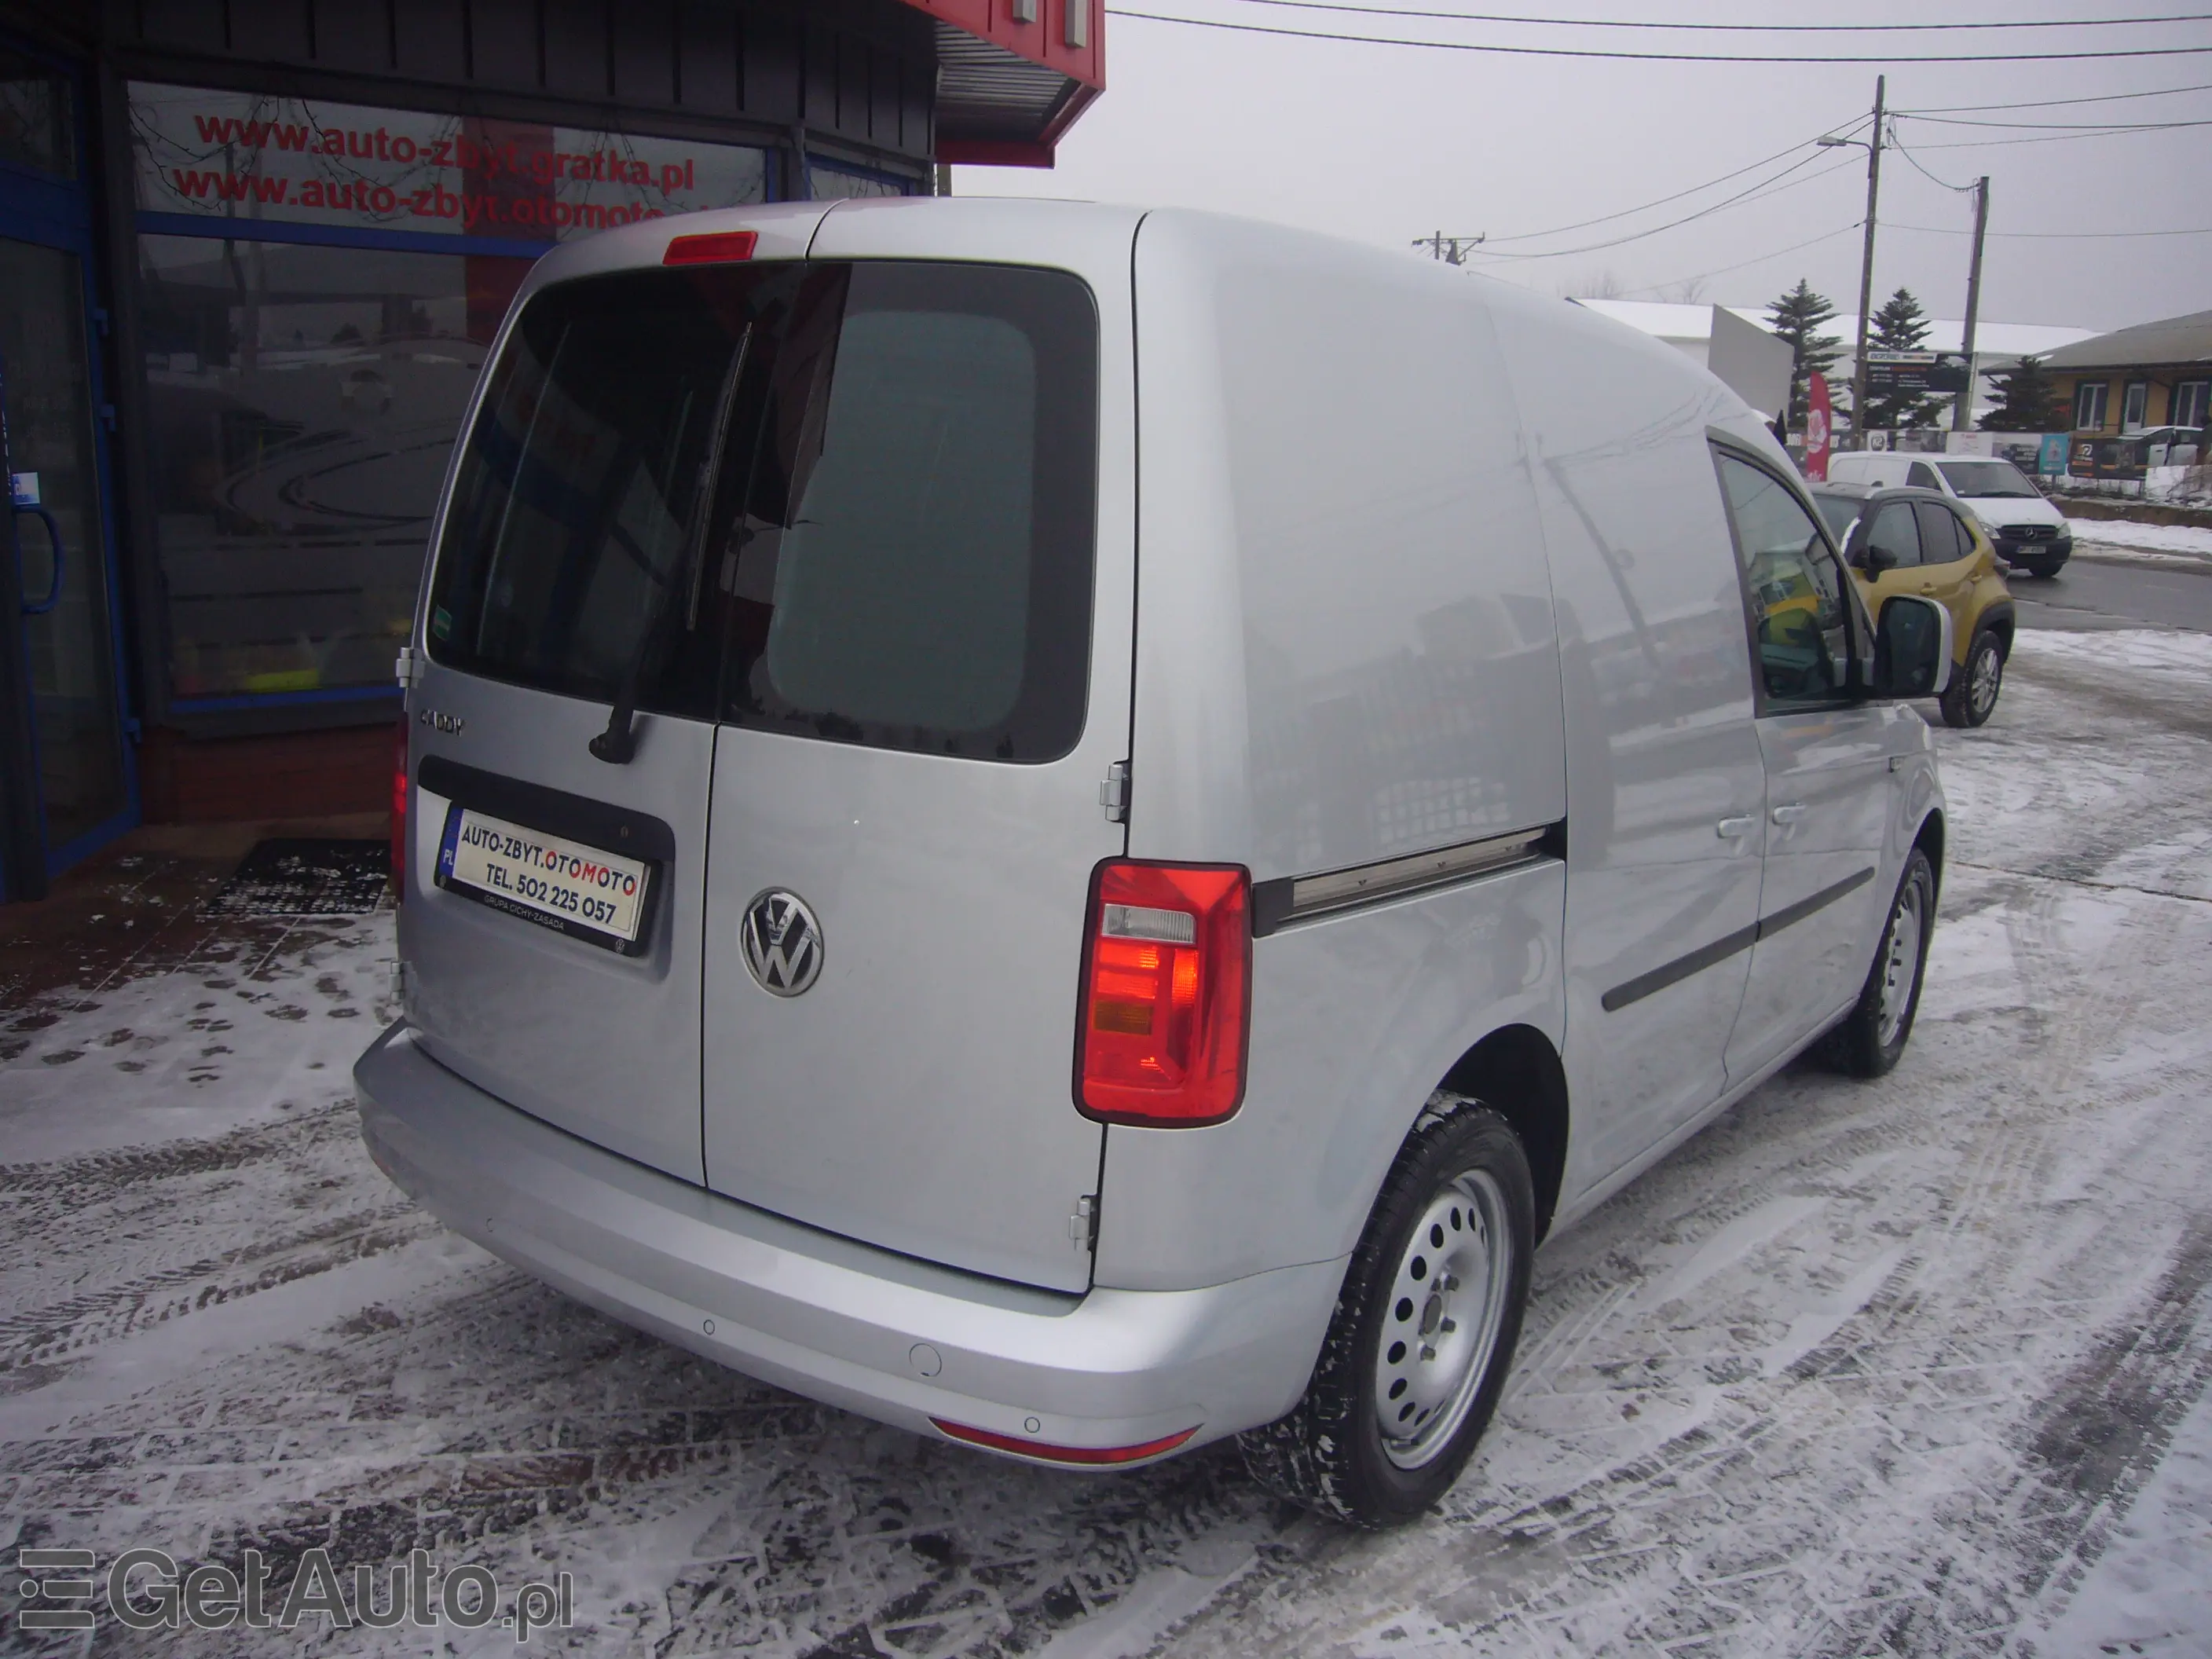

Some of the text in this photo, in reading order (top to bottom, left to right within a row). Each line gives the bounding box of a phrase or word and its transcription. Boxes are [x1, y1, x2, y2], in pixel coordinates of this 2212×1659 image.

[194, 115, 694, 194] www.auto-zbyt.gratka.pl
[443, 848, 455, 866] PL
[461, 824, 636, 895] AUTO-ZBYT.OTOMOTO
[484, 895, 566, 931] GRUPA CICHY-ZASADA
[486, 862, 617, 925] TEL. 502 225 057
